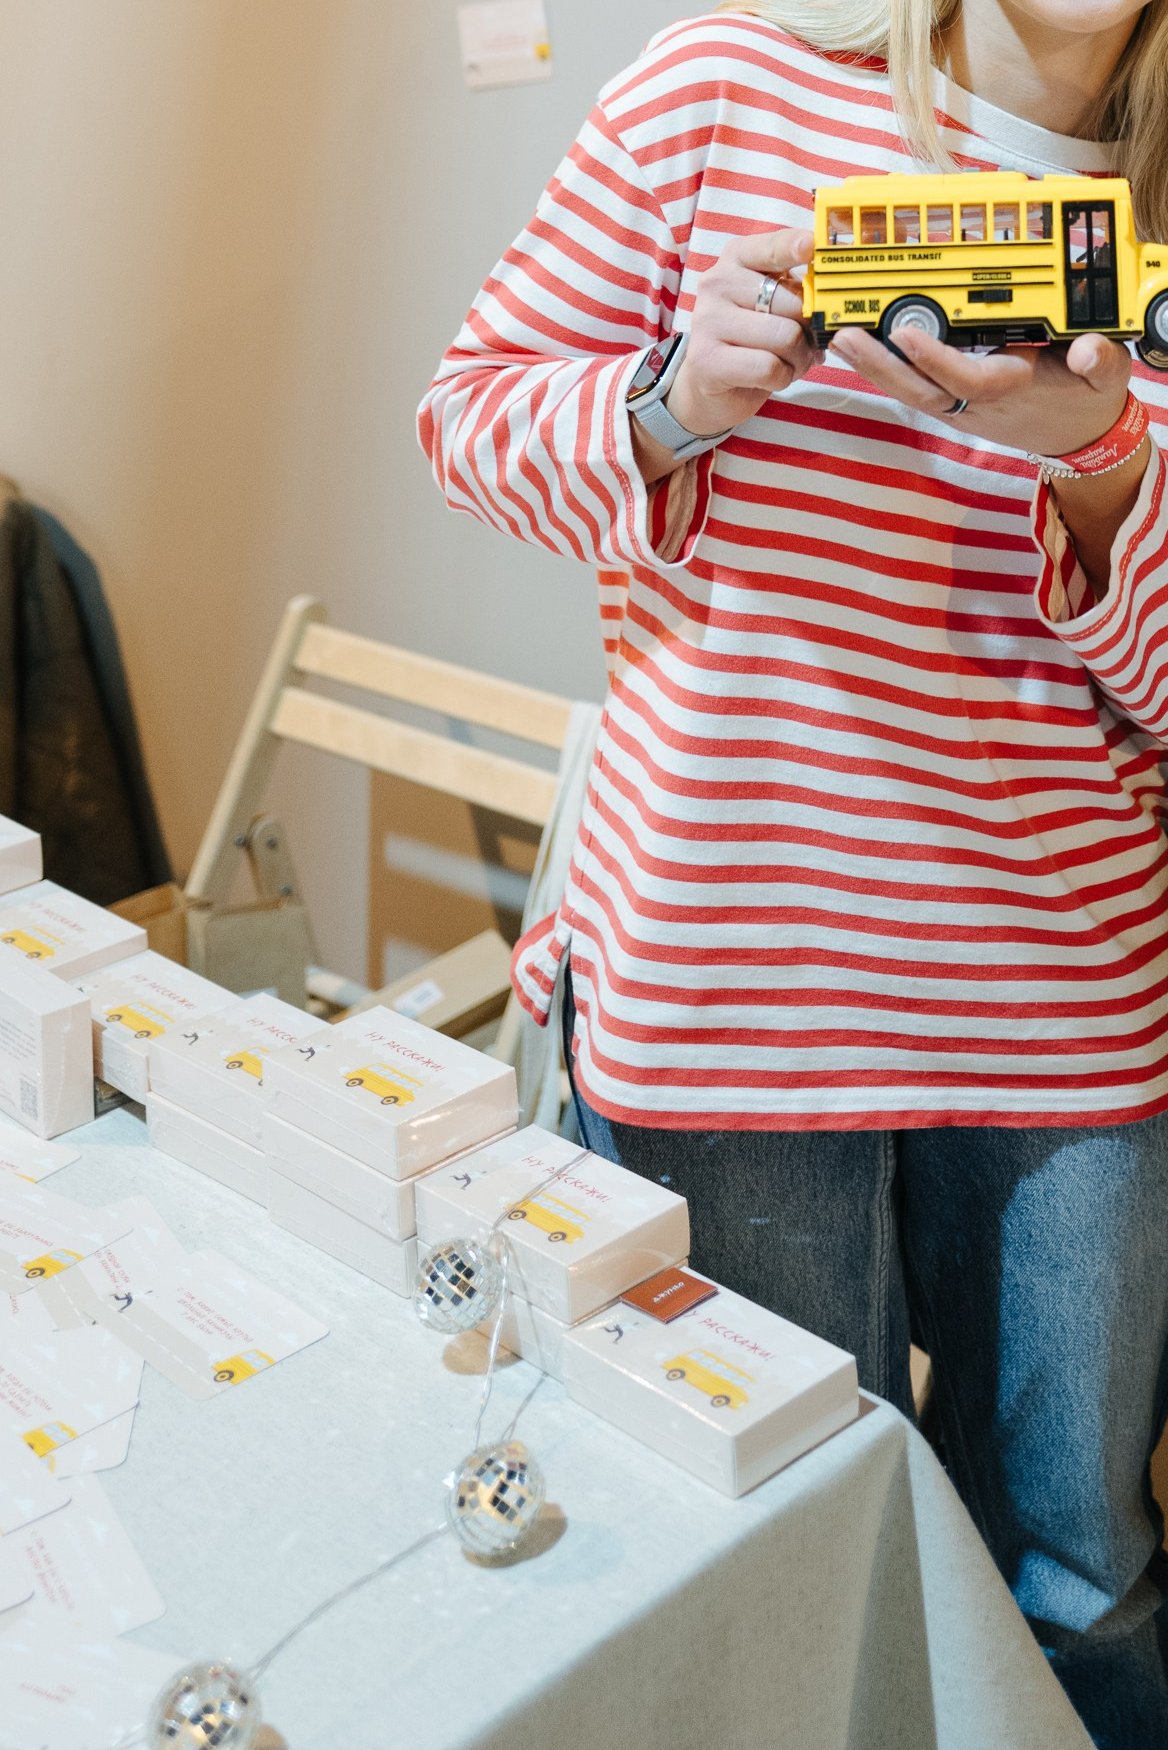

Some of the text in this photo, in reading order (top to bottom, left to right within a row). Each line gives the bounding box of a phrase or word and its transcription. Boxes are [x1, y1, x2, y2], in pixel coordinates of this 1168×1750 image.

[821, 252, 943, 264] CONSOLIDATED BUS TRANSIT
[844, 299, 880, 314] SCHOOL BUS
[363, 1031, 447, 1072] НУ РАССКАЖИ!
[521, 1155, 544, 1167] НУ
[698, 1317, 778, 1362] РАССКАЖИ!
